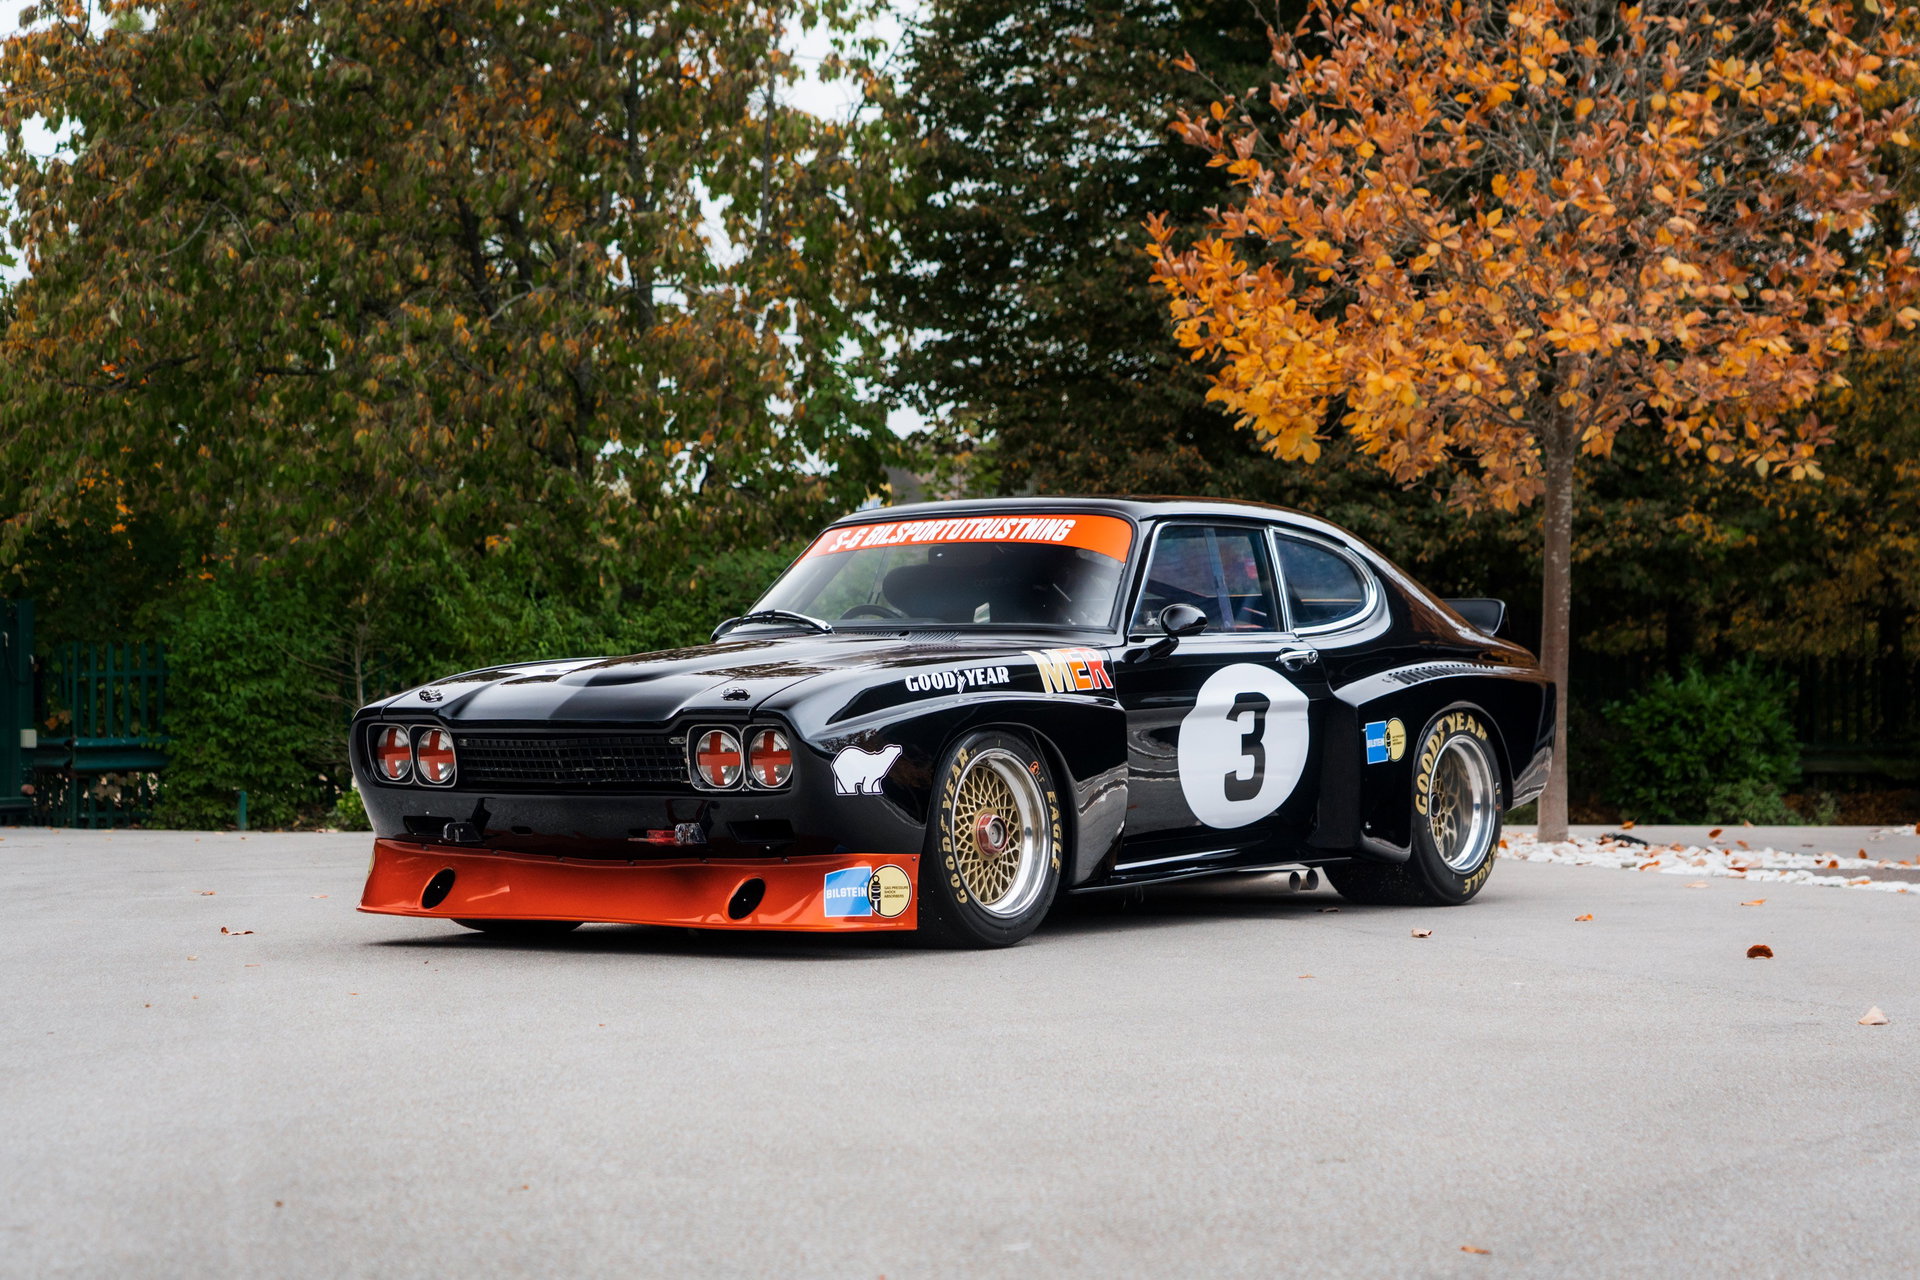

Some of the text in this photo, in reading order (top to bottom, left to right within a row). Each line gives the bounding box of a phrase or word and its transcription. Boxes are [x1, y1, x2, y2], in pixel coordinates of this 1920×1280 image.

[860, 517, 1077, 546] BILSPORTUTRUSTNING
[1022, 646, 1114, 694] MER
[1224, 691, 1271, 802] 3
[1046, 790, 1064, 876] EAGLE
[827, 887, 867, 899] BILSTEIN
